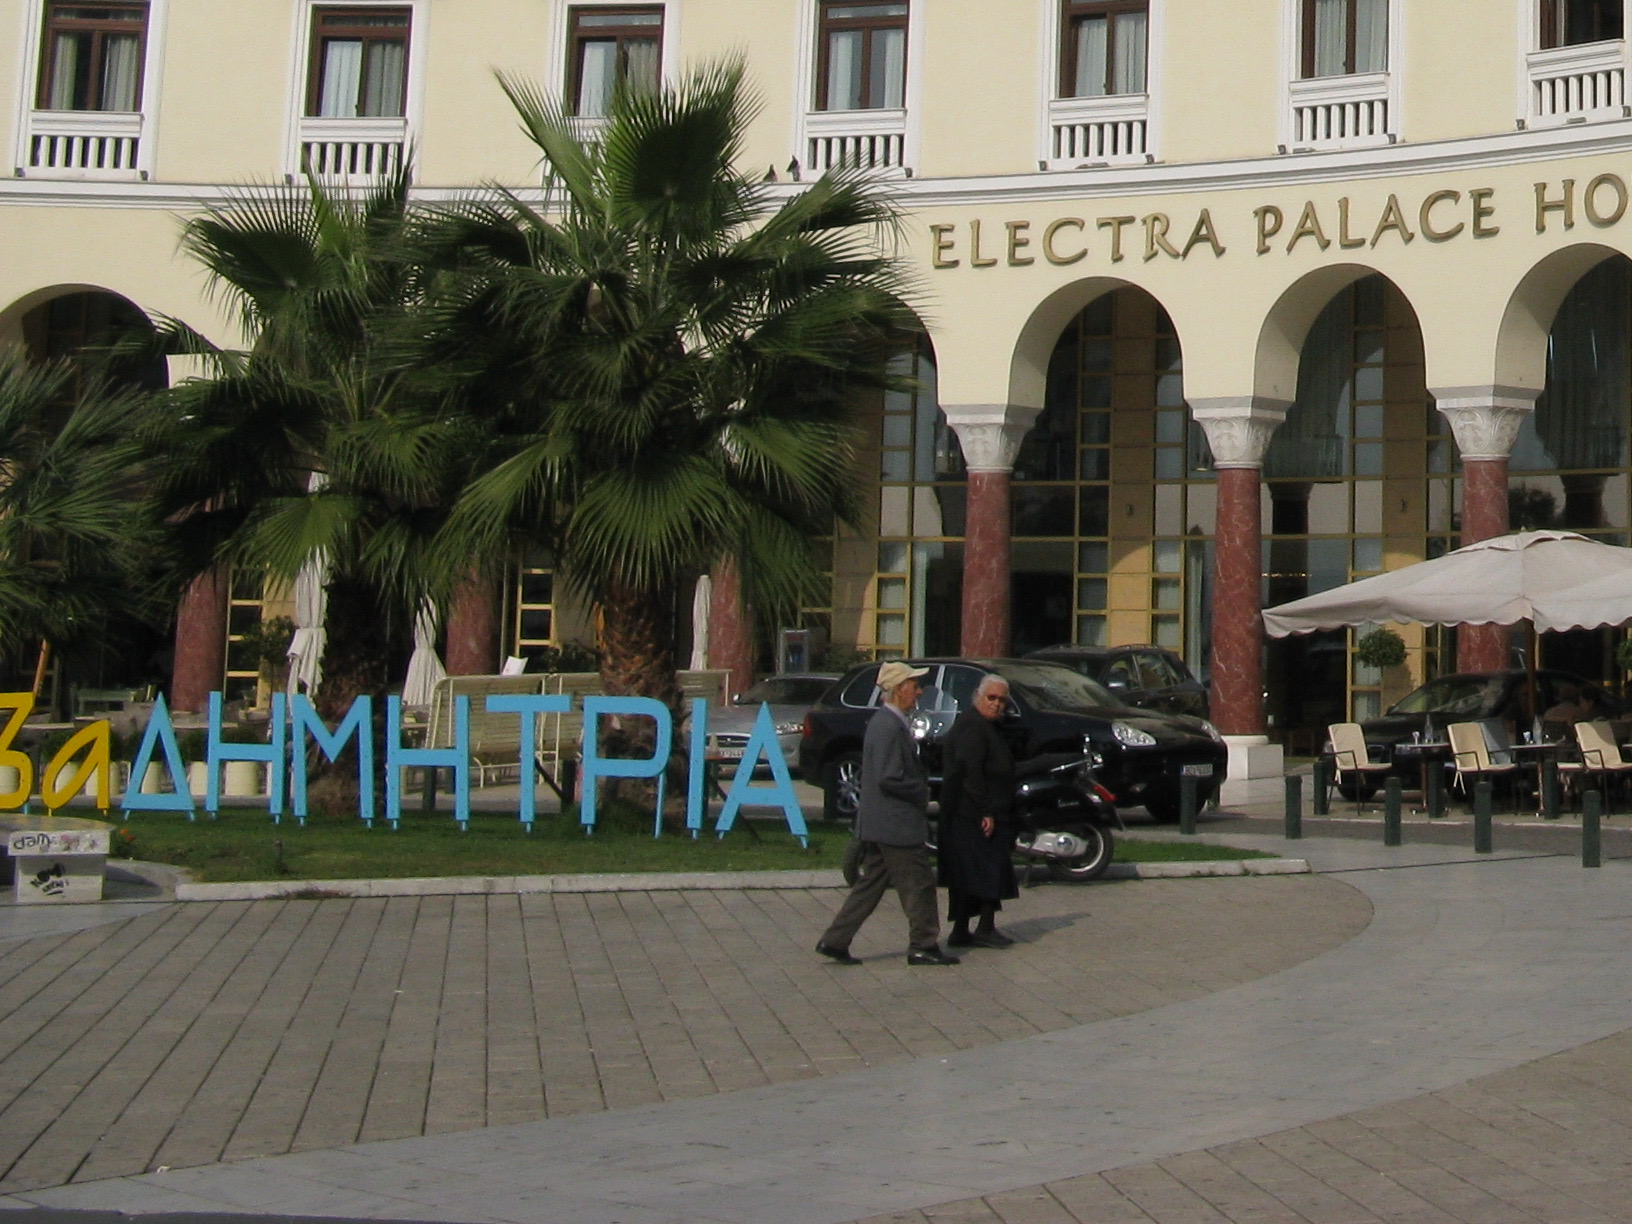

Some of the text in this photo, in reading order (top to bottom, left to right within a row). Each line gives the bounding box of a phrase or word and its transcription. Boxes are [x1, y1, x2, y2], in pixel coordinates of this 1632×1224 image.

[930, 208, 1226, 269] ELECTRA
[1253, 188, 1501, 254] PALACE
[121, 691, 808, 842] ΔΗΜΗΤΡΙΑ
